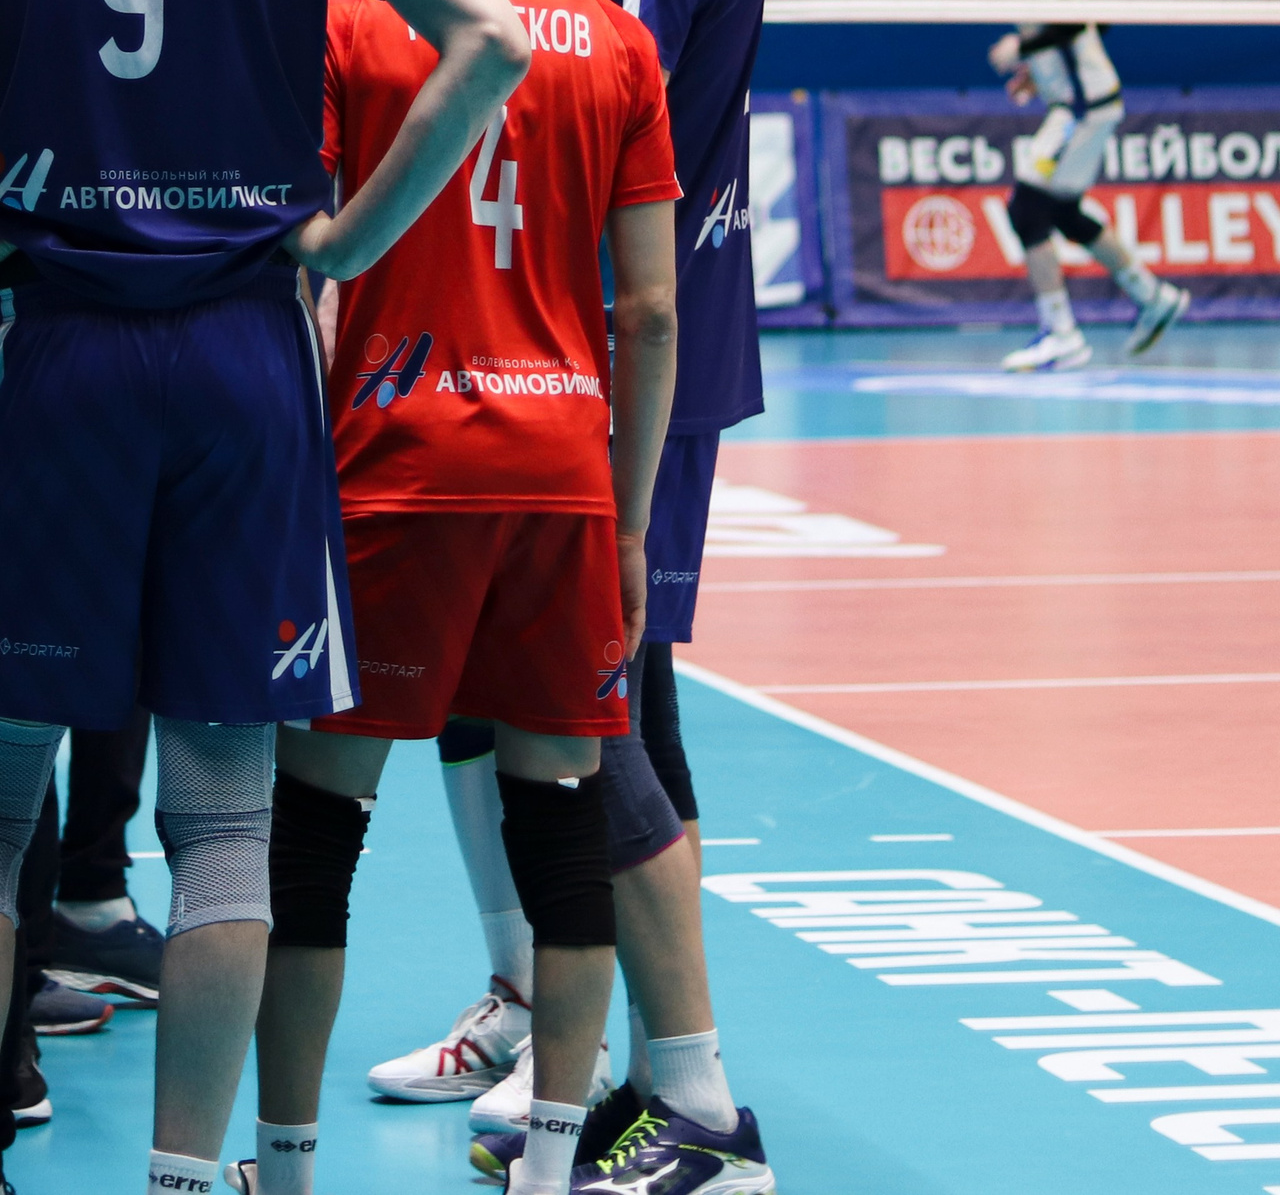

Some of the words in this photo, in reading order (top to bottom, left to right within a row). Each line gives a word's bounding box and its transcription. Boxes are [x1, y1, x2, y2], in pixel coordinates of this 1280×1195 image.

[878, 135, 1005, 184] ВЕСЬ
[99, 169, 207, 181] ВОЛЕЙБОЛЬНЫЙ
[212, 169, 241, 181] КЛУБ
[469, 105, 523, 269] 4
[59, 184, 292, 211] АВТОМОБИЛИСТ
[472, 355, 560, 370] ВОЛЕЙБОЛЬНЫЙ
[435, 370, 604, 400] АВТОМОБИЛИС
[13, 642, 80, 658] SPORTART
[357, 660, 426, 678] PORTART
[159, 1173, 213, 1193] erre
